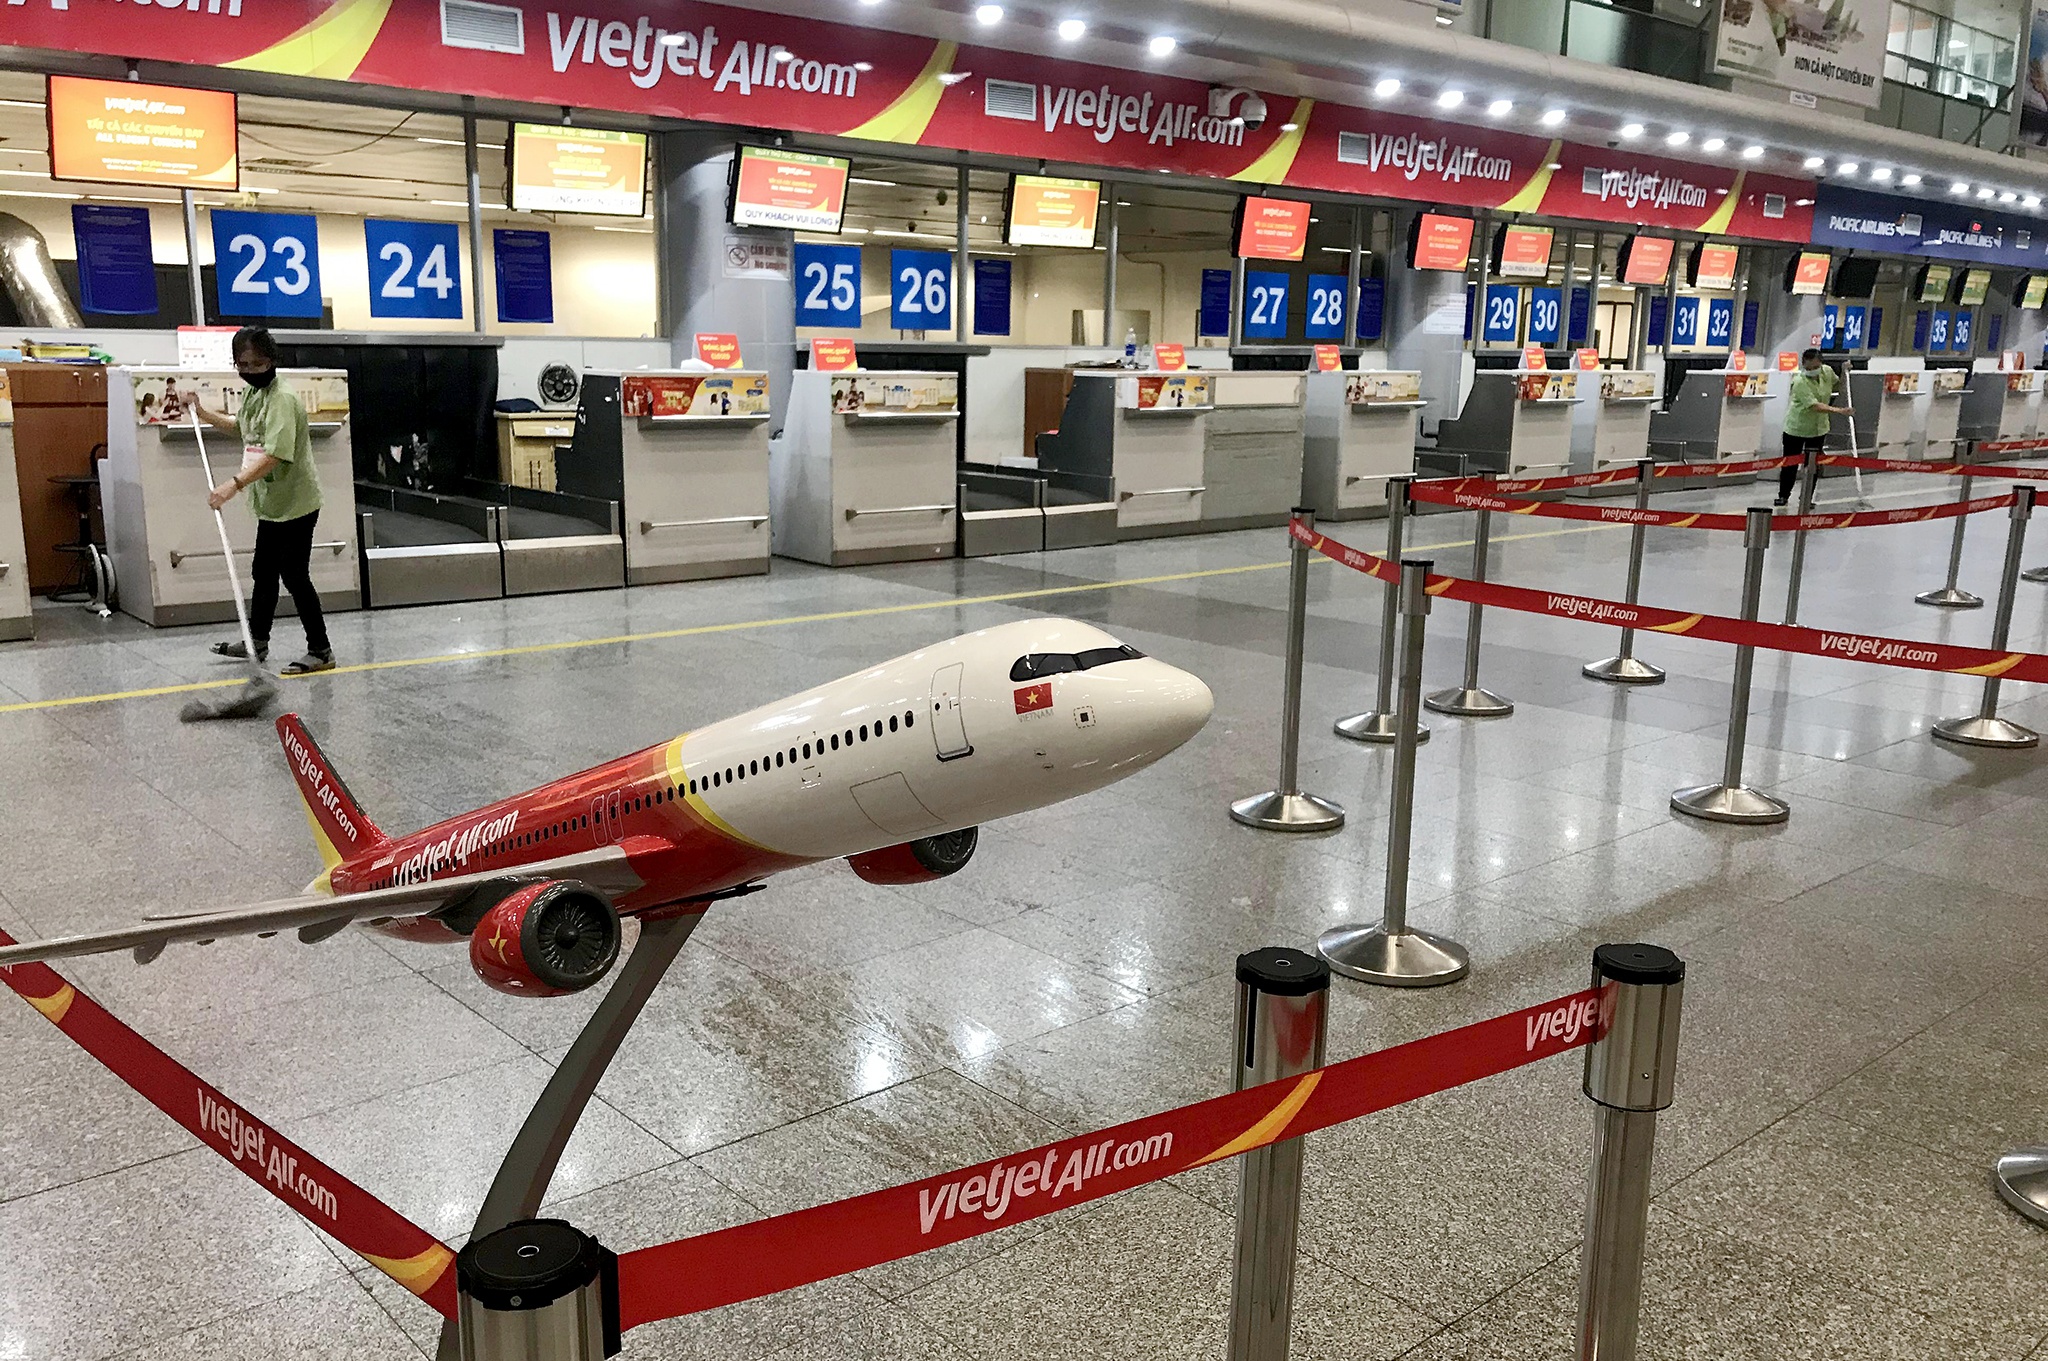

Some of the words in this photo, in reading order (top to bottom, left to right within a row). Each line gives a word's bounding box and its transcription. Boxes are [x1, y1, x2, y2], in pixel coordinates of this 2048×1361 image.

[229, 234, 310, 296] 23
[380, 242, 453, 299] 24
[804, 262, 855, 311] 25
[900, 267, 946, 314] 26
[1251, 286, 1285, 324] 27
[1311, 288, 1342, 326] 28
[1489, 297, 1515, 330] 29
[1534, 300, 1558, 332] 30
[1677, 307, 1696, 336] 31
[1711, 309, 1730, 337] 32
[1845, 315, 1862, 341] 34
[1932, 320, 1948, 343] 35
[1954, 320, 1970, 344] 36
[1017, 708, 1054, 723] VIETNAM
